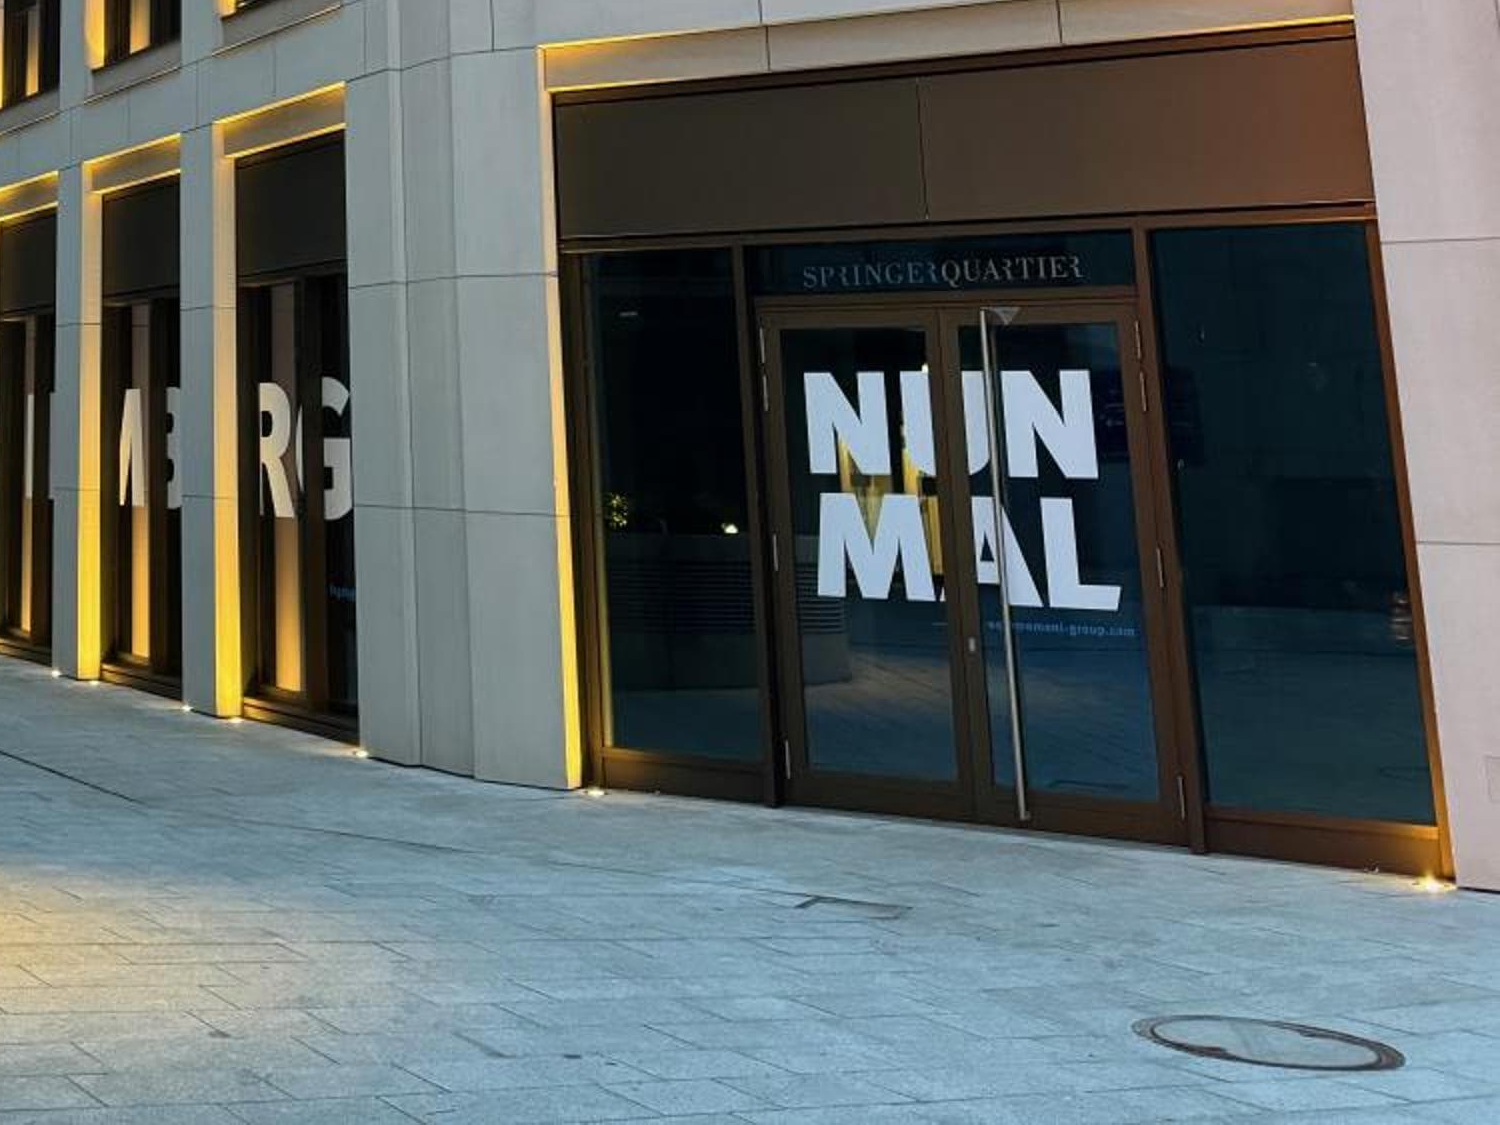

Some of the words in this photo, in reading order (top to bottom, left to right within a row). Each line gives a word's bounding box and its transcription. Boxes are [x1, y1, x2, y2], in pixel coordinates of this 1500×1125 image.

[802, 255, 1086, 289] SPRINGERQUARTIER
[803, 369, 1099, 480] NUN
[817, 491, 1122, 612] MAL
